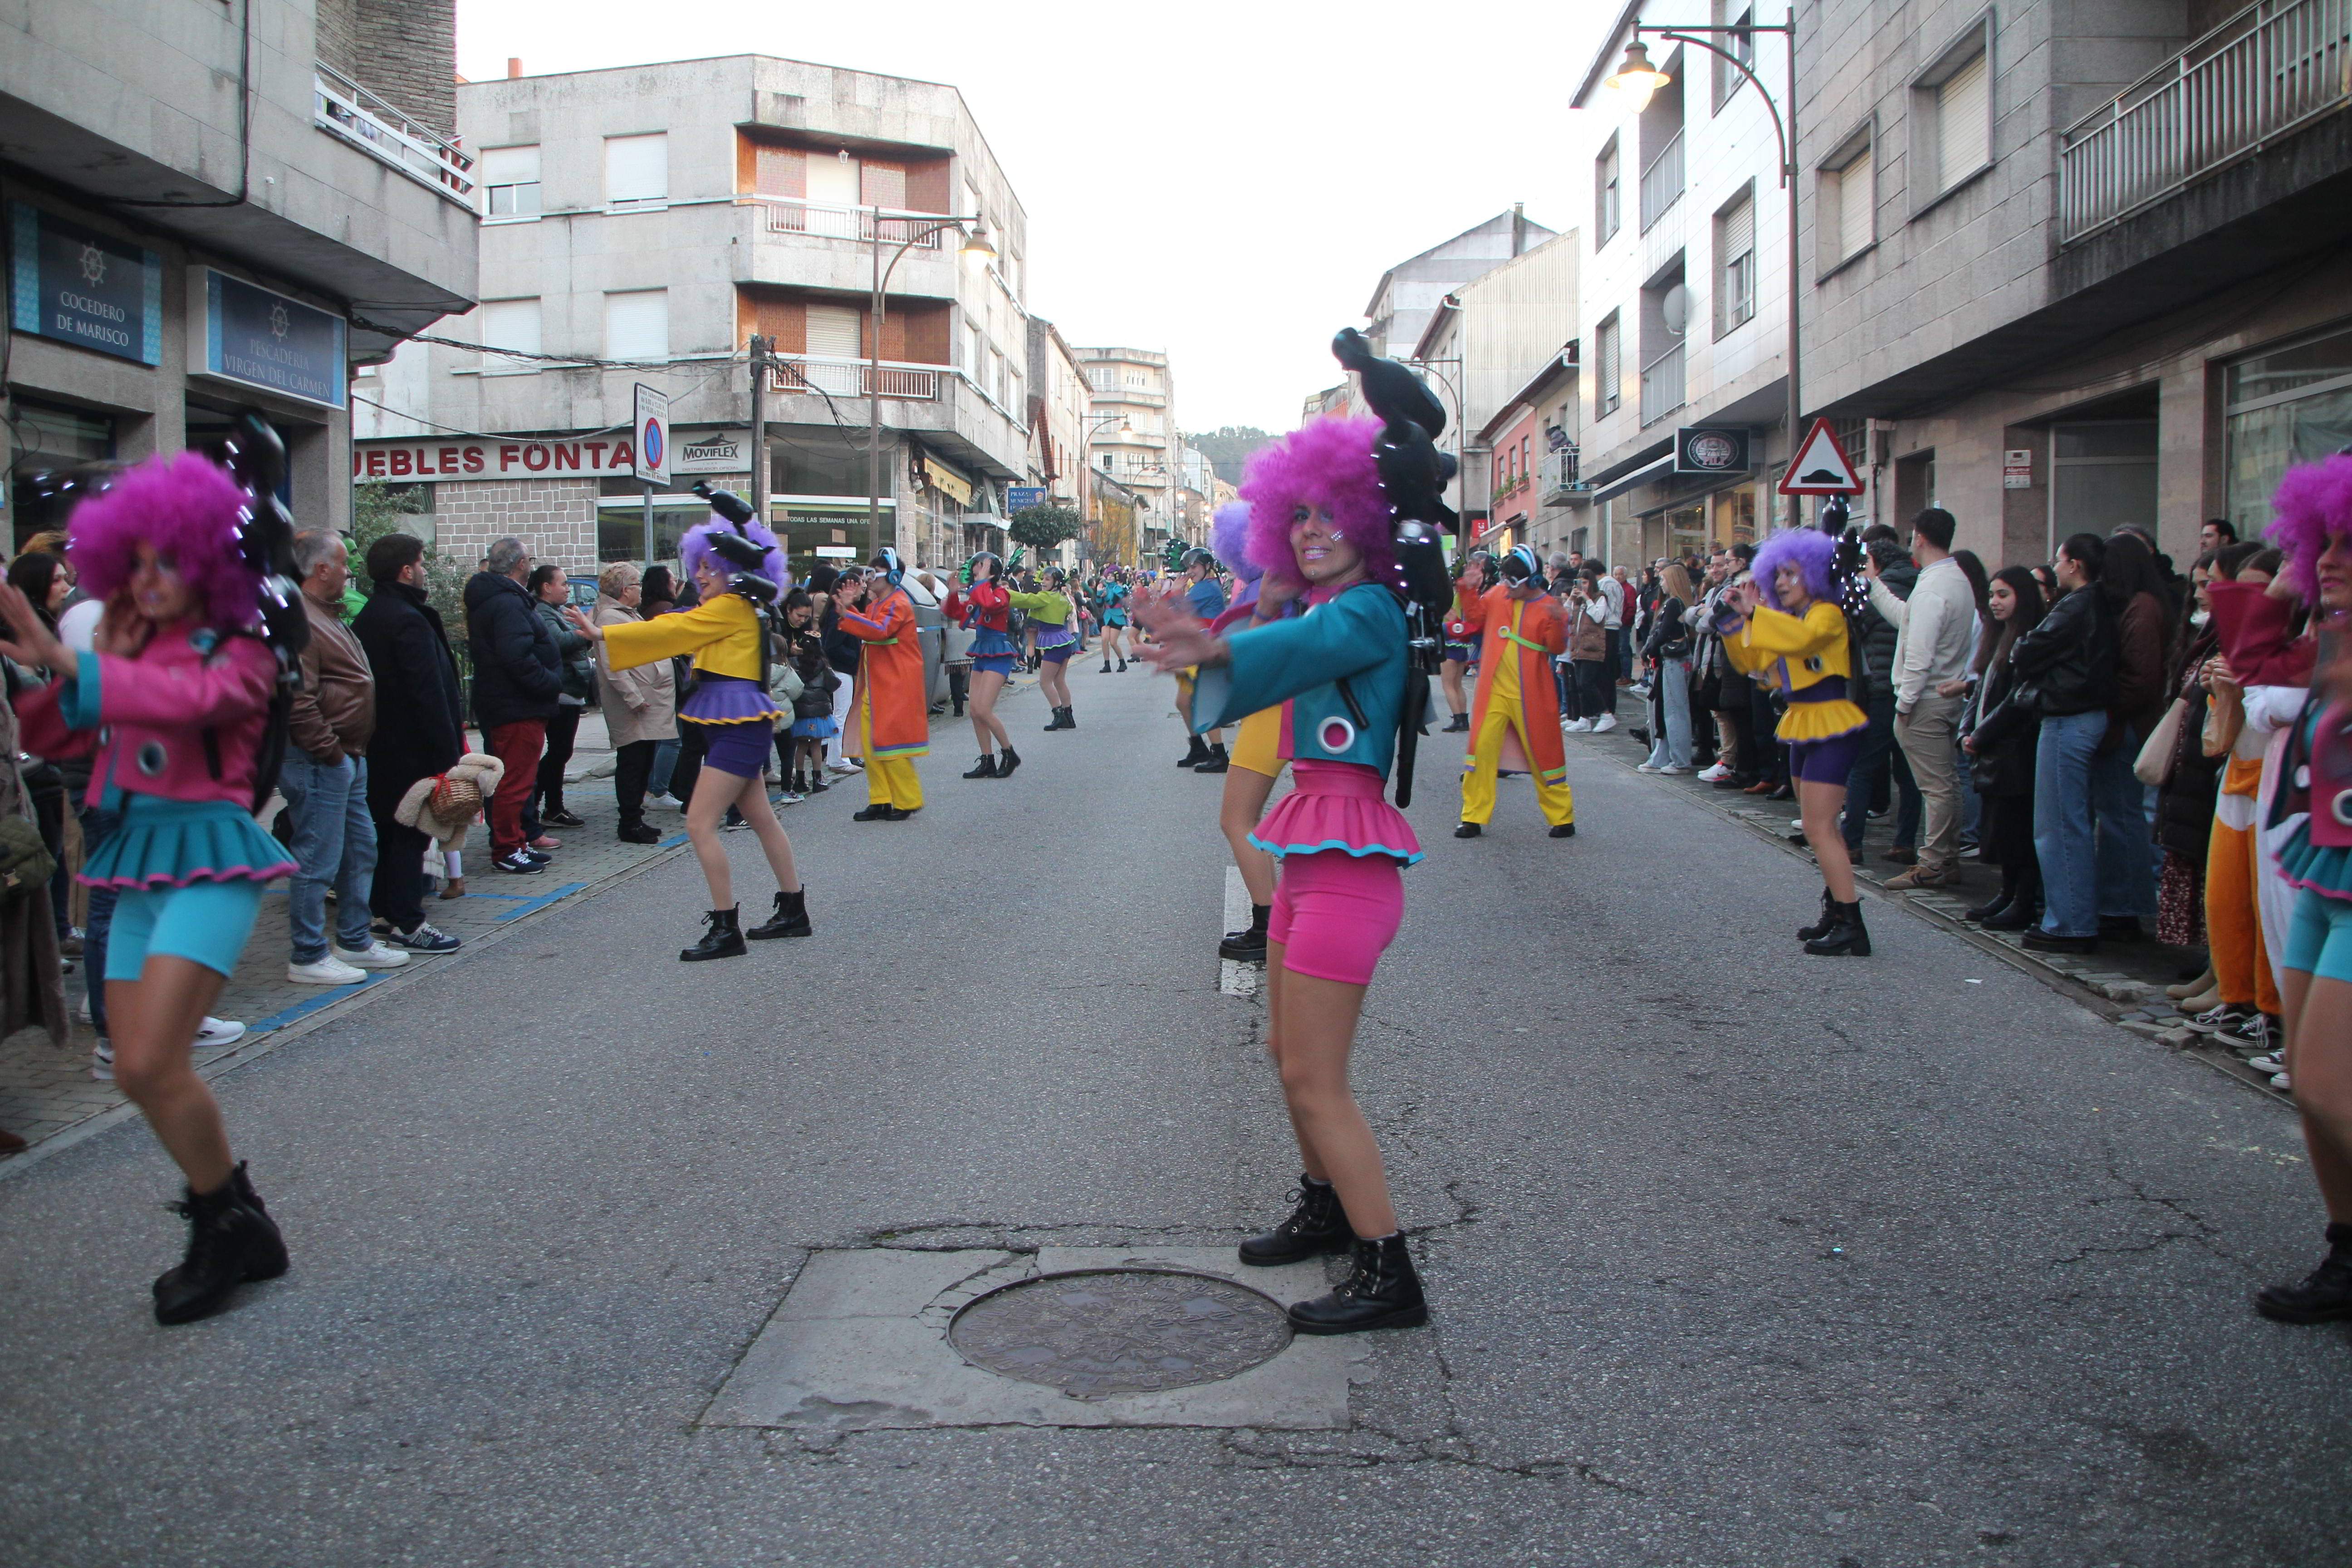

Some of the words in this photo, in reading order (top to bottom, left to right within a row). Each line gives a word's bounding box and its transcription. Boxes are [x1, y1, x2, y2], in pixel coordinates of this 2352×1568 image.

[61, 291, 125, 322] COCEDERO
[57, 314, 73, 332] DE
[77, 320, 128, 347] MARISCO
[250, 339, 309, 371] PESCADERÍA
[225, 354, 265, 379] VIRGEN
[269, 367, 287, 386] DEL
[290, 373, 330, 398] CARMEN
[648, 391, 667, 404] laborables
[682, 444, 739, 461] MOVIFLEX
[657, 475, 669, 483] minutos
